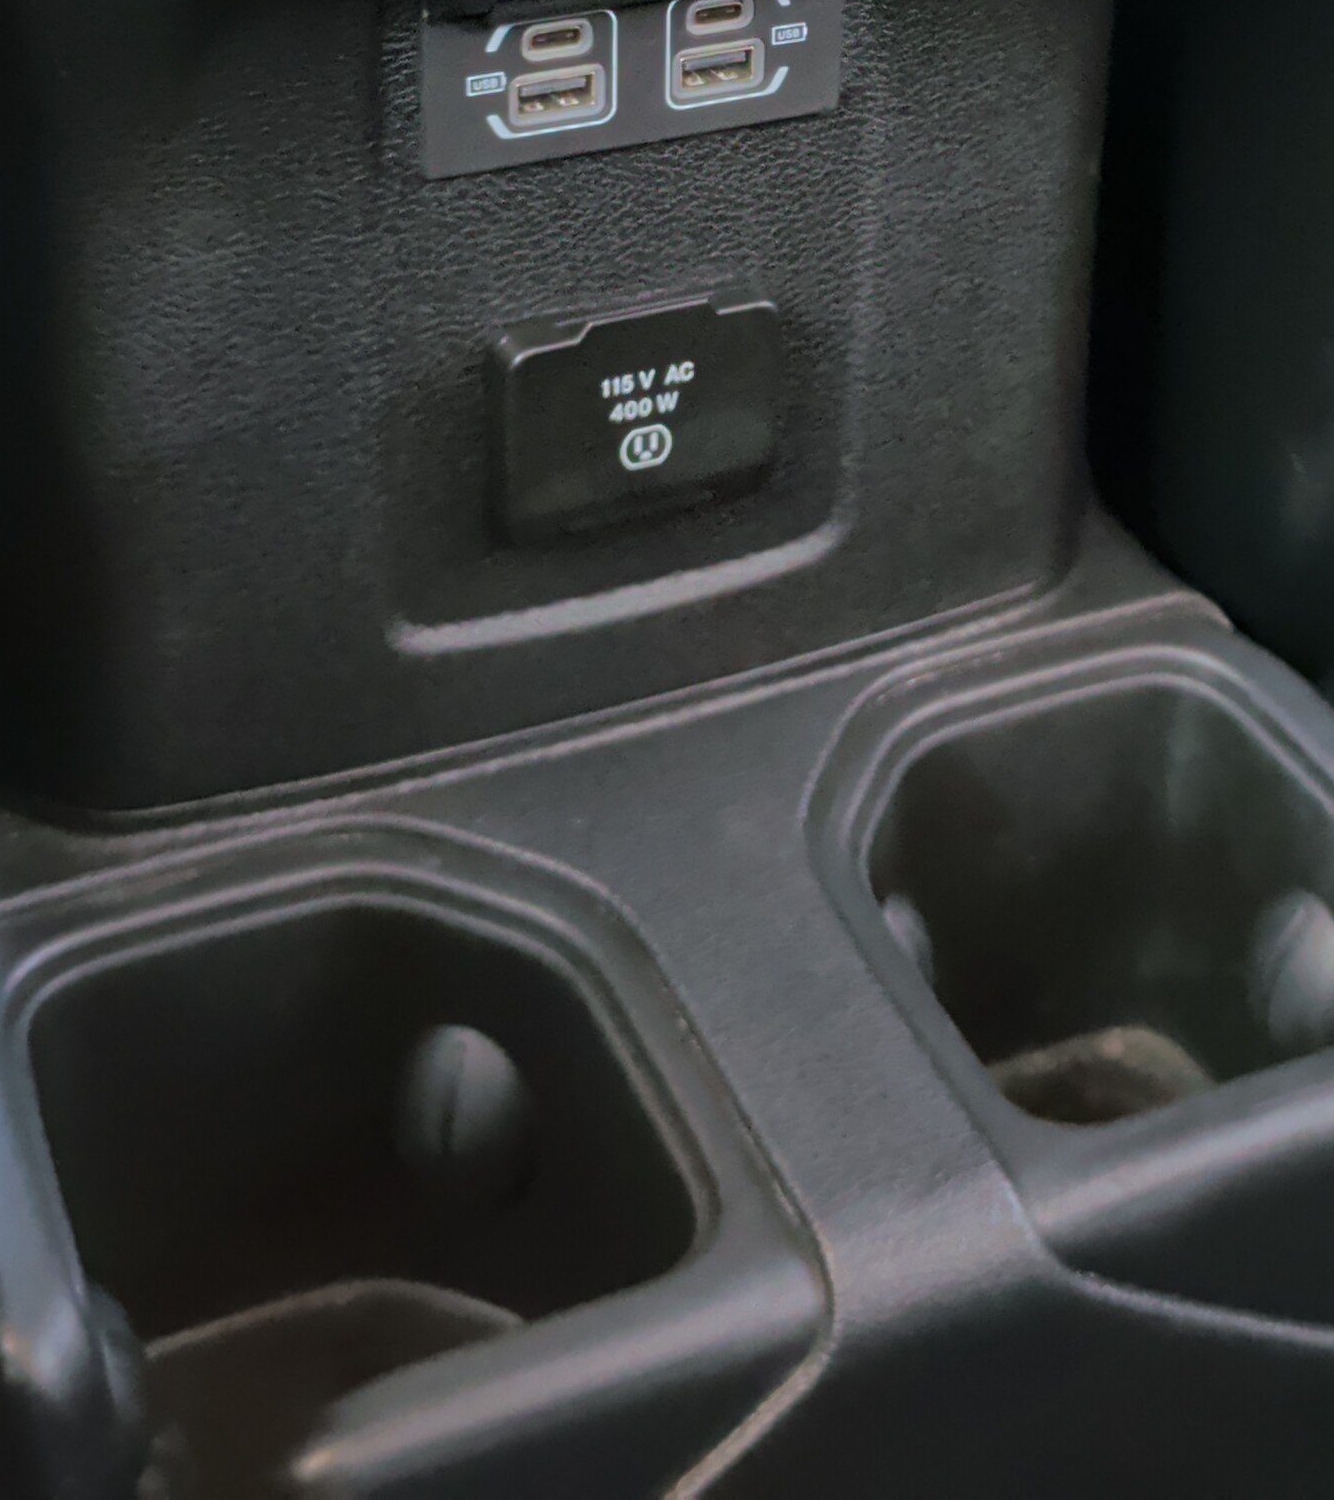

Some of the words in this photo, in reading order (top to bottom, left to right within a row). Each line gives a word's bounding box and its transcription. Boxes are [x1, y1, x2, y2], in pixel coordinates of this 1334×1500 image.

[777, 27, 800, 41] USB
[472, 78, 498, 91] USB
[600, 374, 635, 398] 115
[638, 368, 656, 390] V
[663, 361, 695, 385] AC
[609, 397, 653, 423] 400
[656, 390, 680, 413] W
